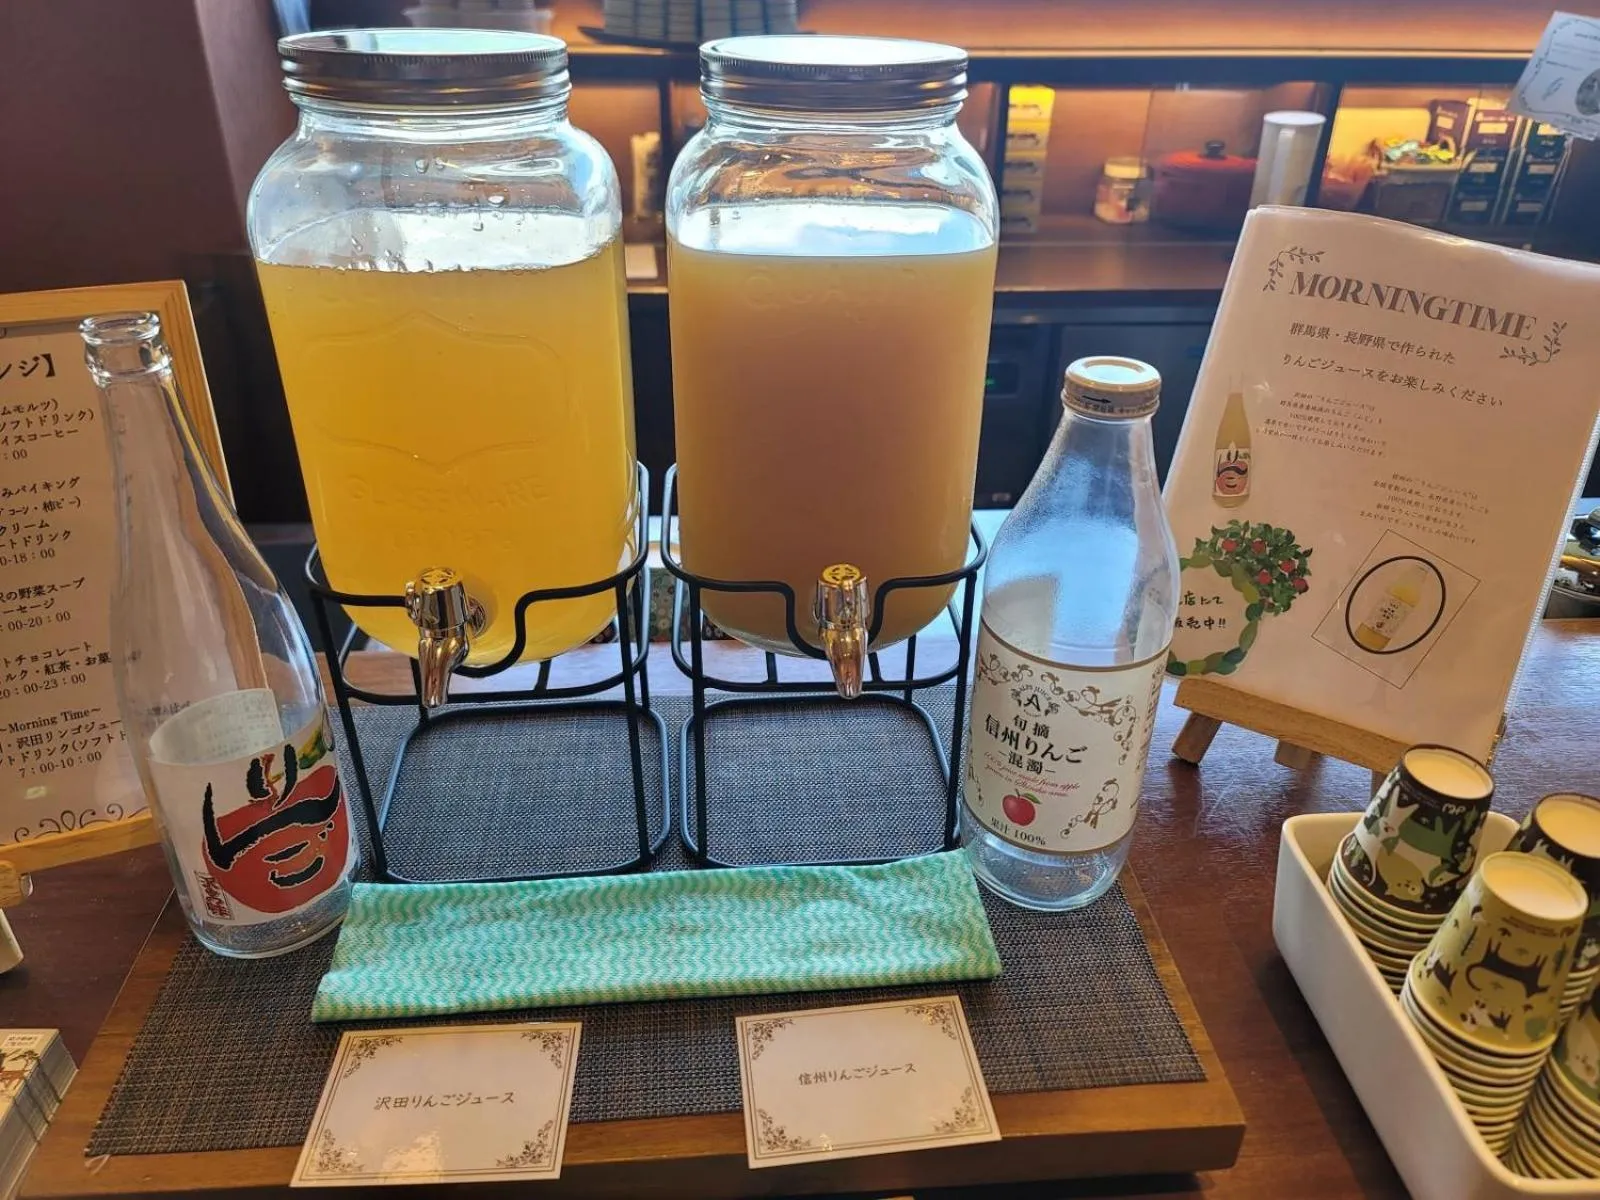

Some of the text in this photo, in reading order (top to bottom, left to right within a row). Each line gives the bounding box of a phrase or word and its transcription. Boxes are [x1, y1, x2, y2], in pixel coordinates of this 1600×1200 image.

[1289, 271, 1537, 341] MORNINGTIME
[1290, 321, 1456, 365] 群馬県・長野県で作られた
[1282, 352, 1504, 407] りんごジュースをお楽しみください
[1178, 590, 1223, 606] 店にて
[0, 720, 121, 754] ・沢田リンゴジュー
[985, 713, 1088, 764] 信州りんご
[798, 1062, 917, 1085] 信州りんごジュース
[374, 1091, 515, 1110] 沢田りんごジュース
